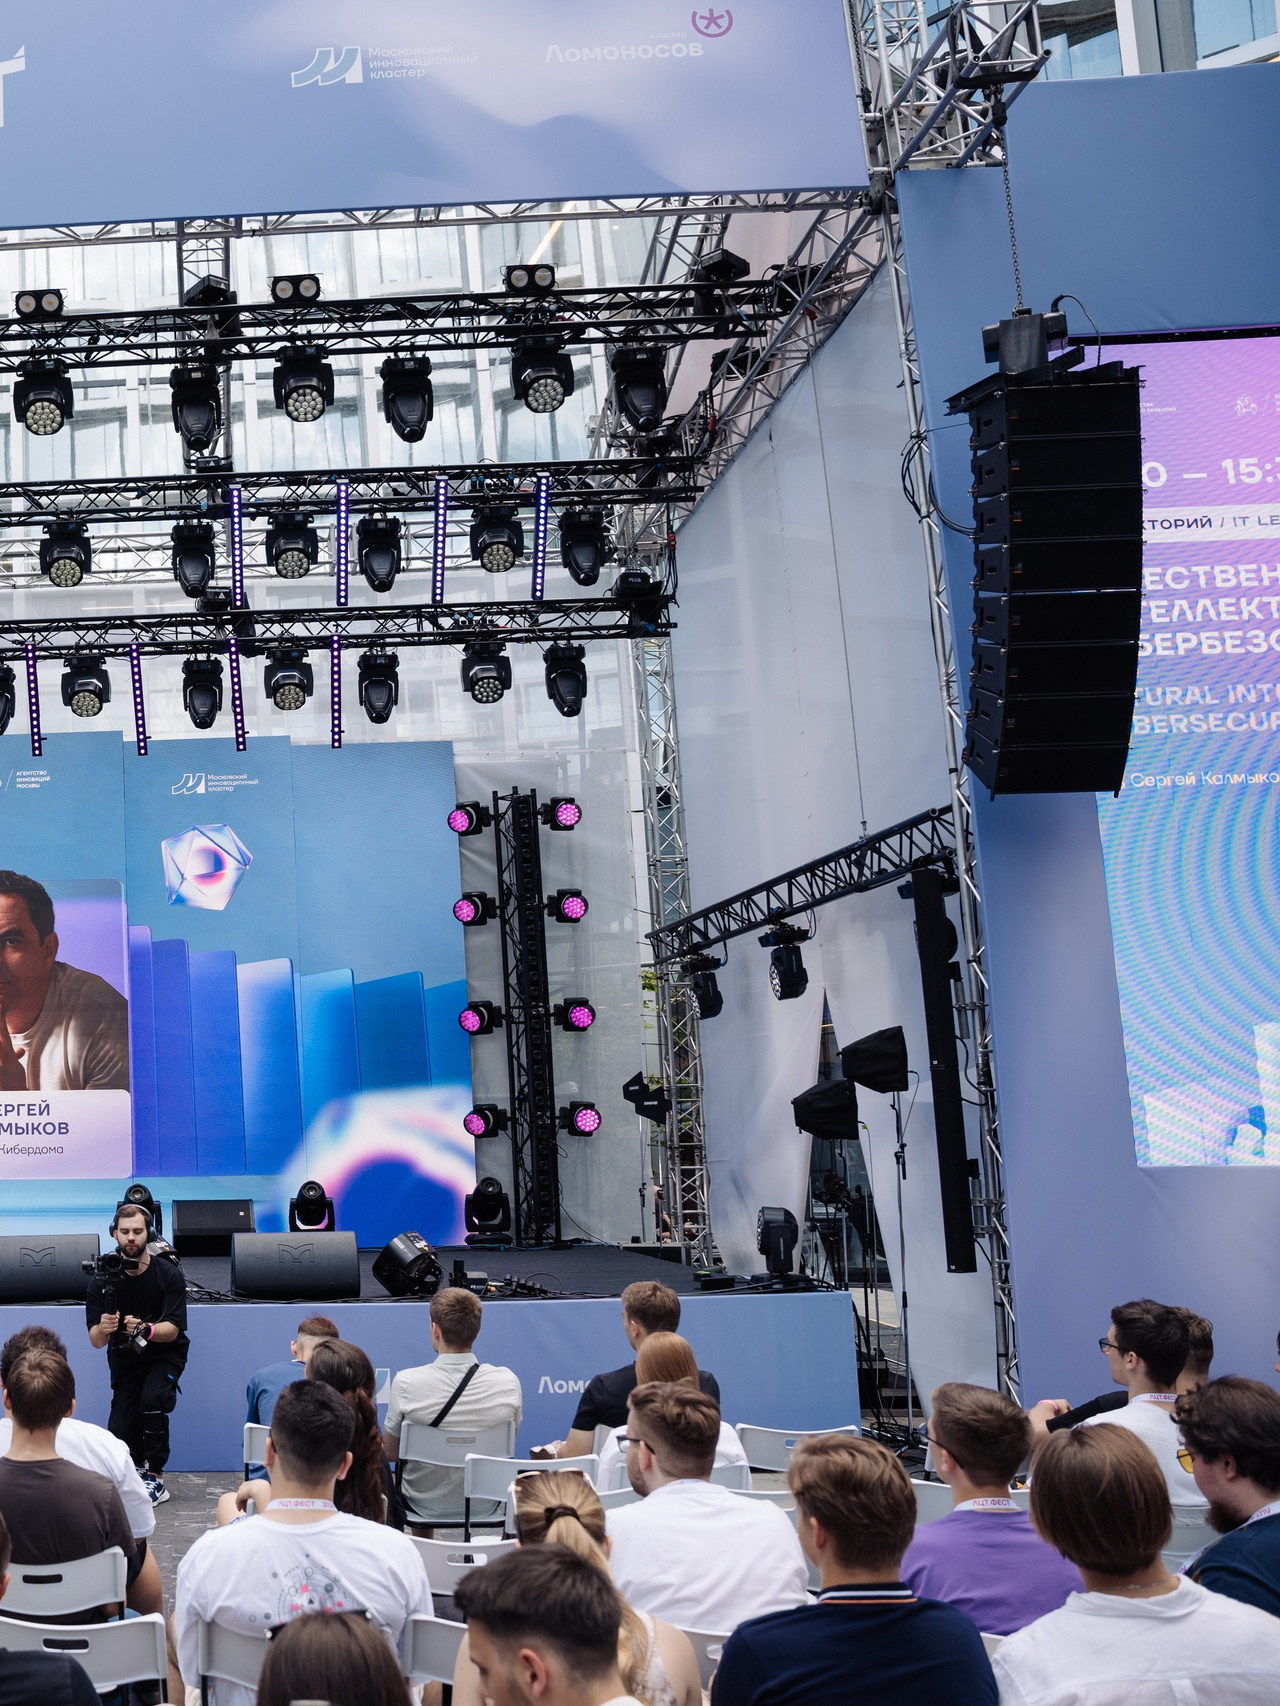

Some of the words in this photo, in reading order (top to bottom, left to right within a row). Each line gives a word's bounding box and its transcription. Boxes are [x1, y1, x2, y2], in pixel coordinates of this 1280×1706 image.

[650, 31, 687, 40] кластер
[368, 44, 453, 58] Московский
[545, 42, 704, 63] Ломоносов
[369, 52, 478, 68] инновационный
[370, 68, 426, 79] кластер
[1233, 516, 1249, 527] IT
[1141, 596, 1280, 623] ЕЛЛЕКТ
[207, 773, 248, 781] Московский
[1130, 772, 1196, 789] Сергей
